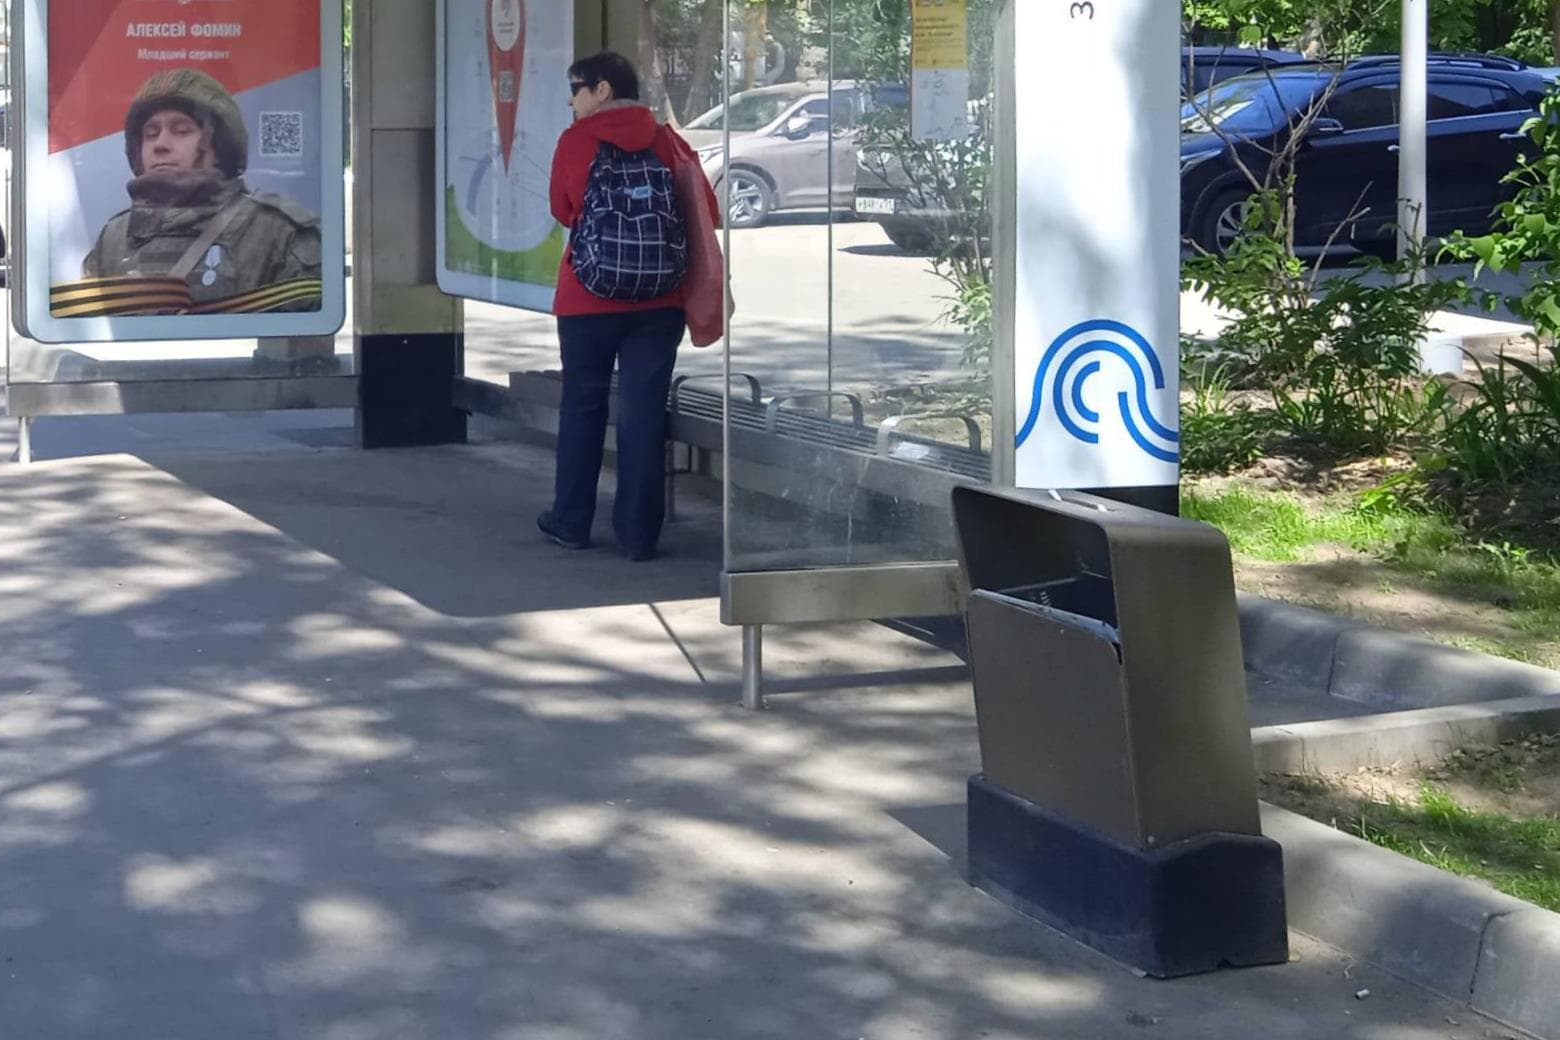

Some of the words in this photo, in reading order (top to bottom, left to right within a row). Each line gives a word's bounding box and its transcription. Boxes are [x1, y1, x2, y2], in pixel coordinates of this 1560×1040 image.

[126, 20, 186, 37] АЛЕКСЕЙ
[190, 23, 241, 37] ФОМИН
[137, 47, 186, 61] Младший
[188, 49, 230, 62] сержант
